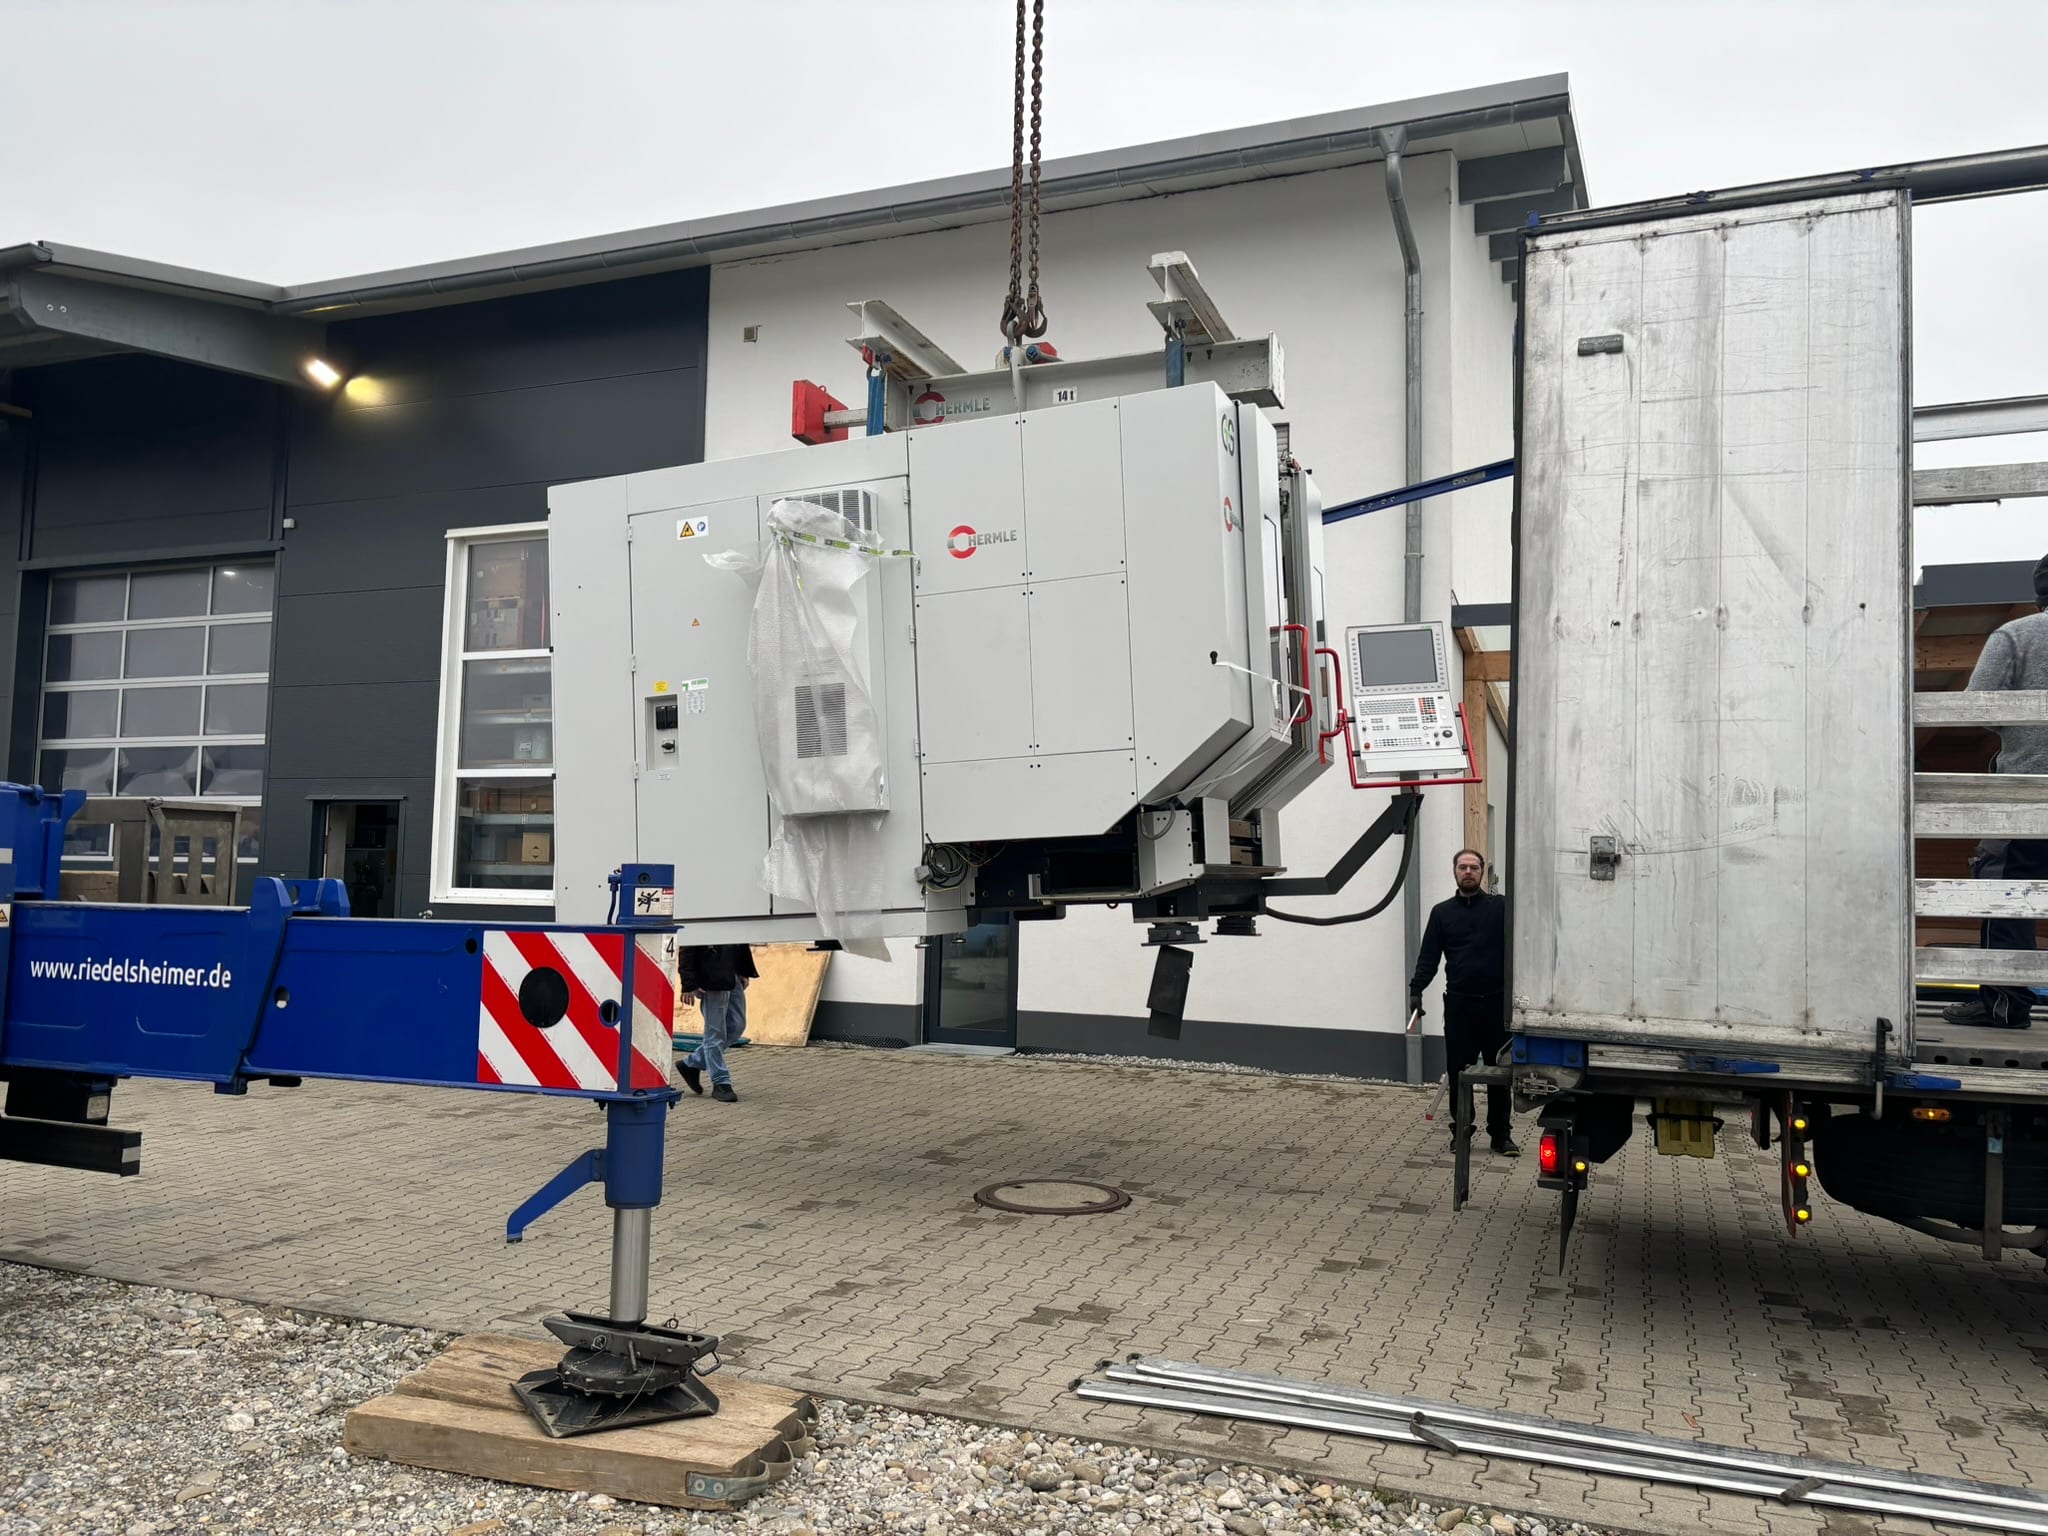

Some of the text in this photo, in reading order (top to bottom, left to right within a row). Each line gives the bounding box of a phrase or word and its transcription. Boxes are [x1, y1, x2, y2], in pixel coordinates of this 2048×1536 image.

[935, 397, 991, 415] HERMLE
[968, 529, 1017, 546] HERMLE
[666, 936, 675, 957] 4
[30, 957, 231, 988] www.riedelsheimer.de
